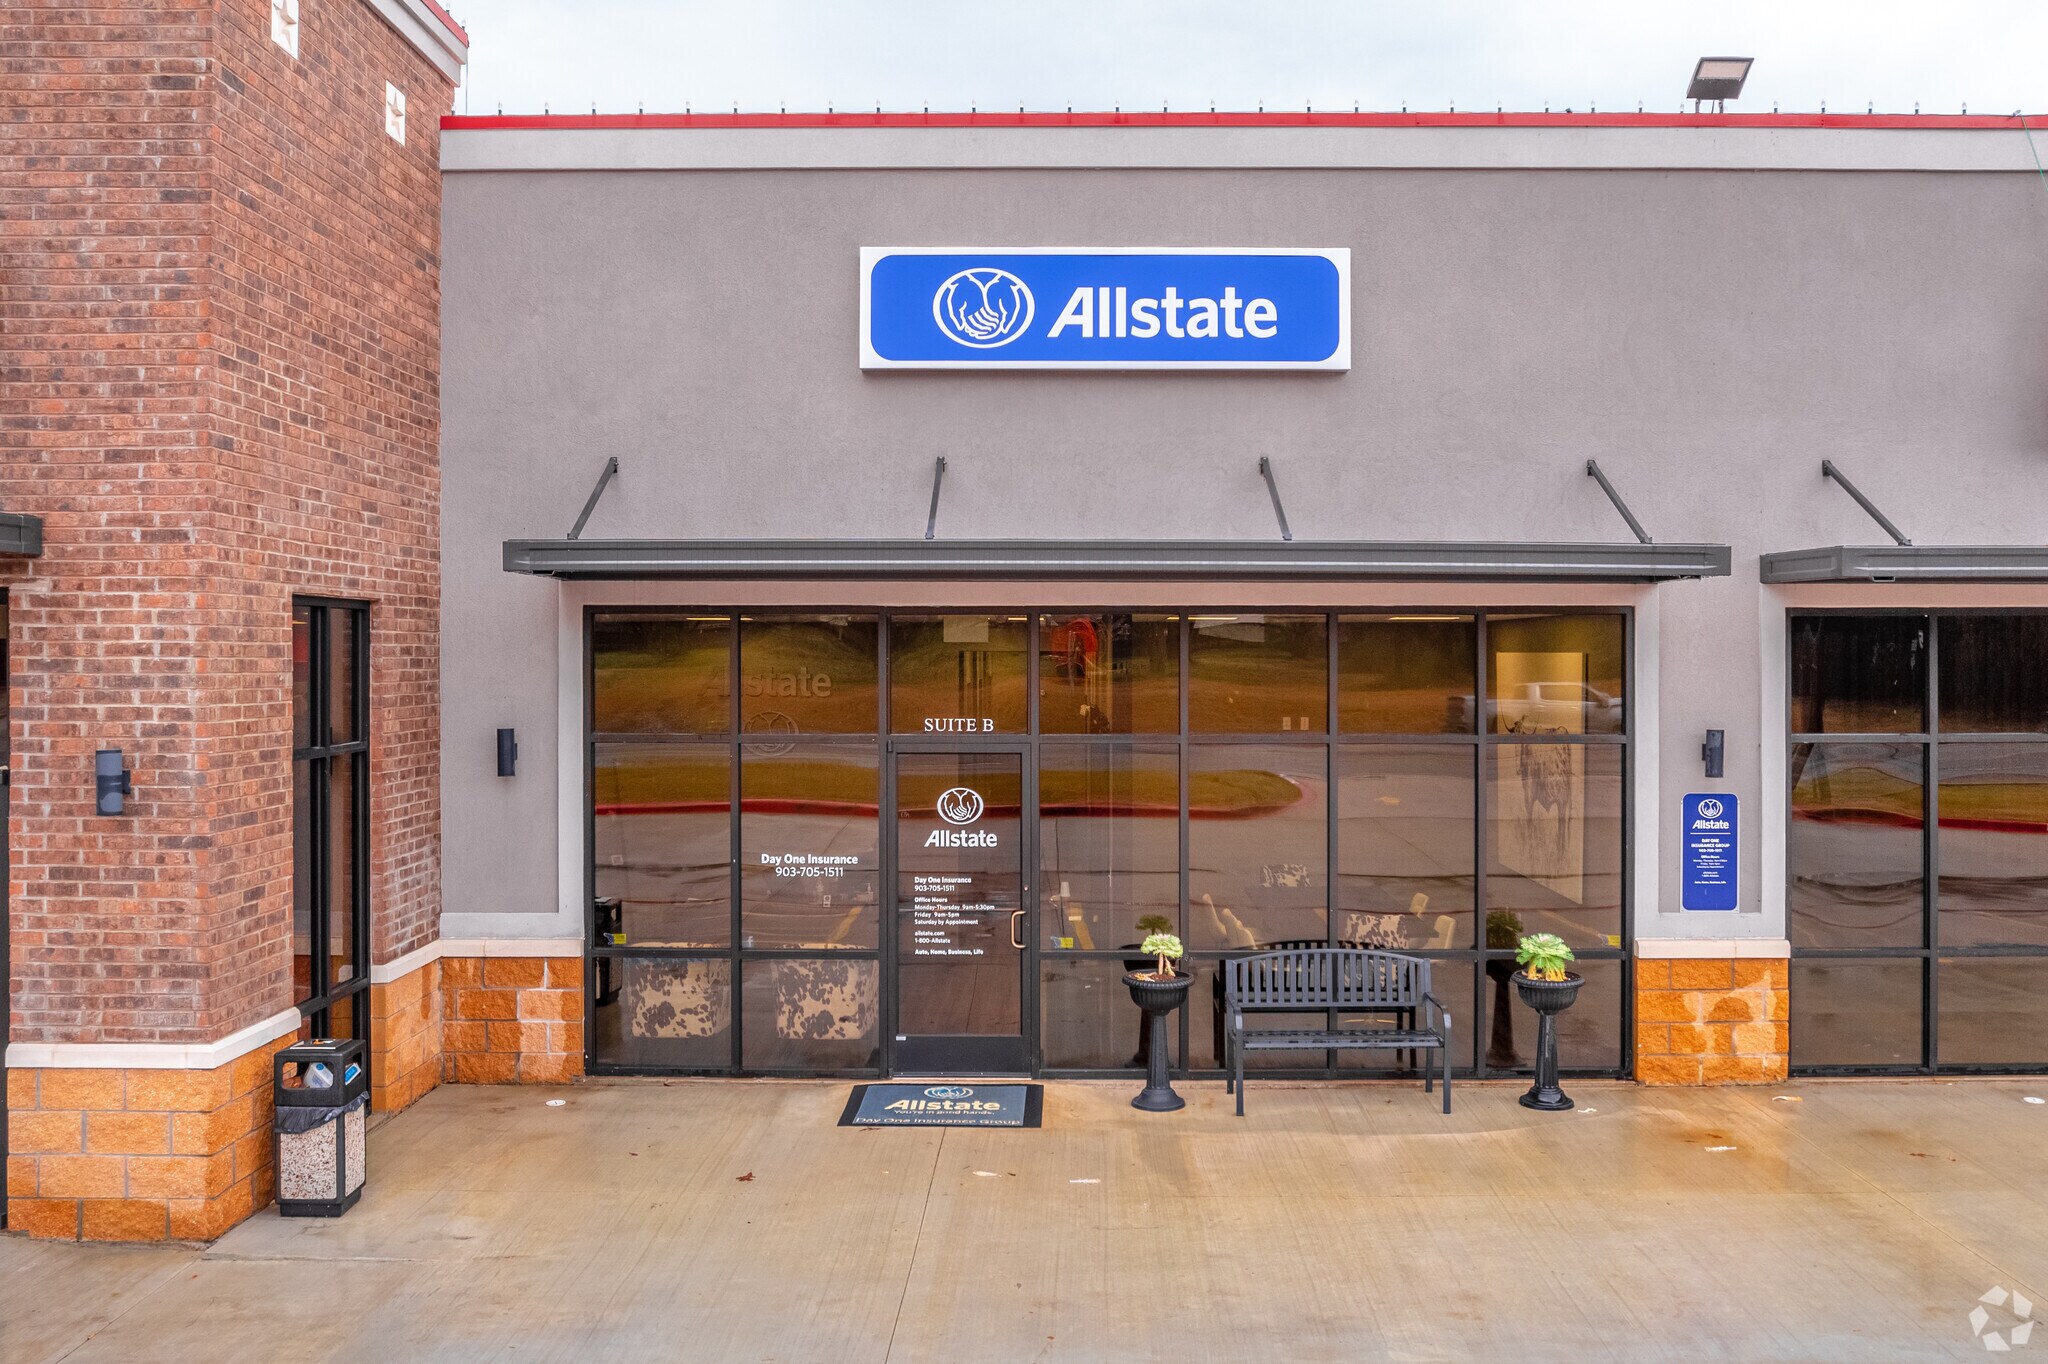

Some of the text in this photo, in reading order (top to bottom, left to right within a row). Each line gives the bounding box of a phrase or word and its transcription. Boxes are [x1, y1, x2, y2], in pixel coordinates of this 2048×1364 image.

[1047, 286, 1278, 338] Allstate
[924, 718, 994, 732] SUITE B
[1692, 820, 1729, 829] Allstate
[924, 830, 998, 848] Allstate
[761, 853, 859, 866] Day One Insurance
[775, 867, 844, 877] 903-705-1511
[914, 876, 926, 885] Day
[941, 876, 972, 884] Insurance
[884, 1099, 1002, 1111] Allstate
